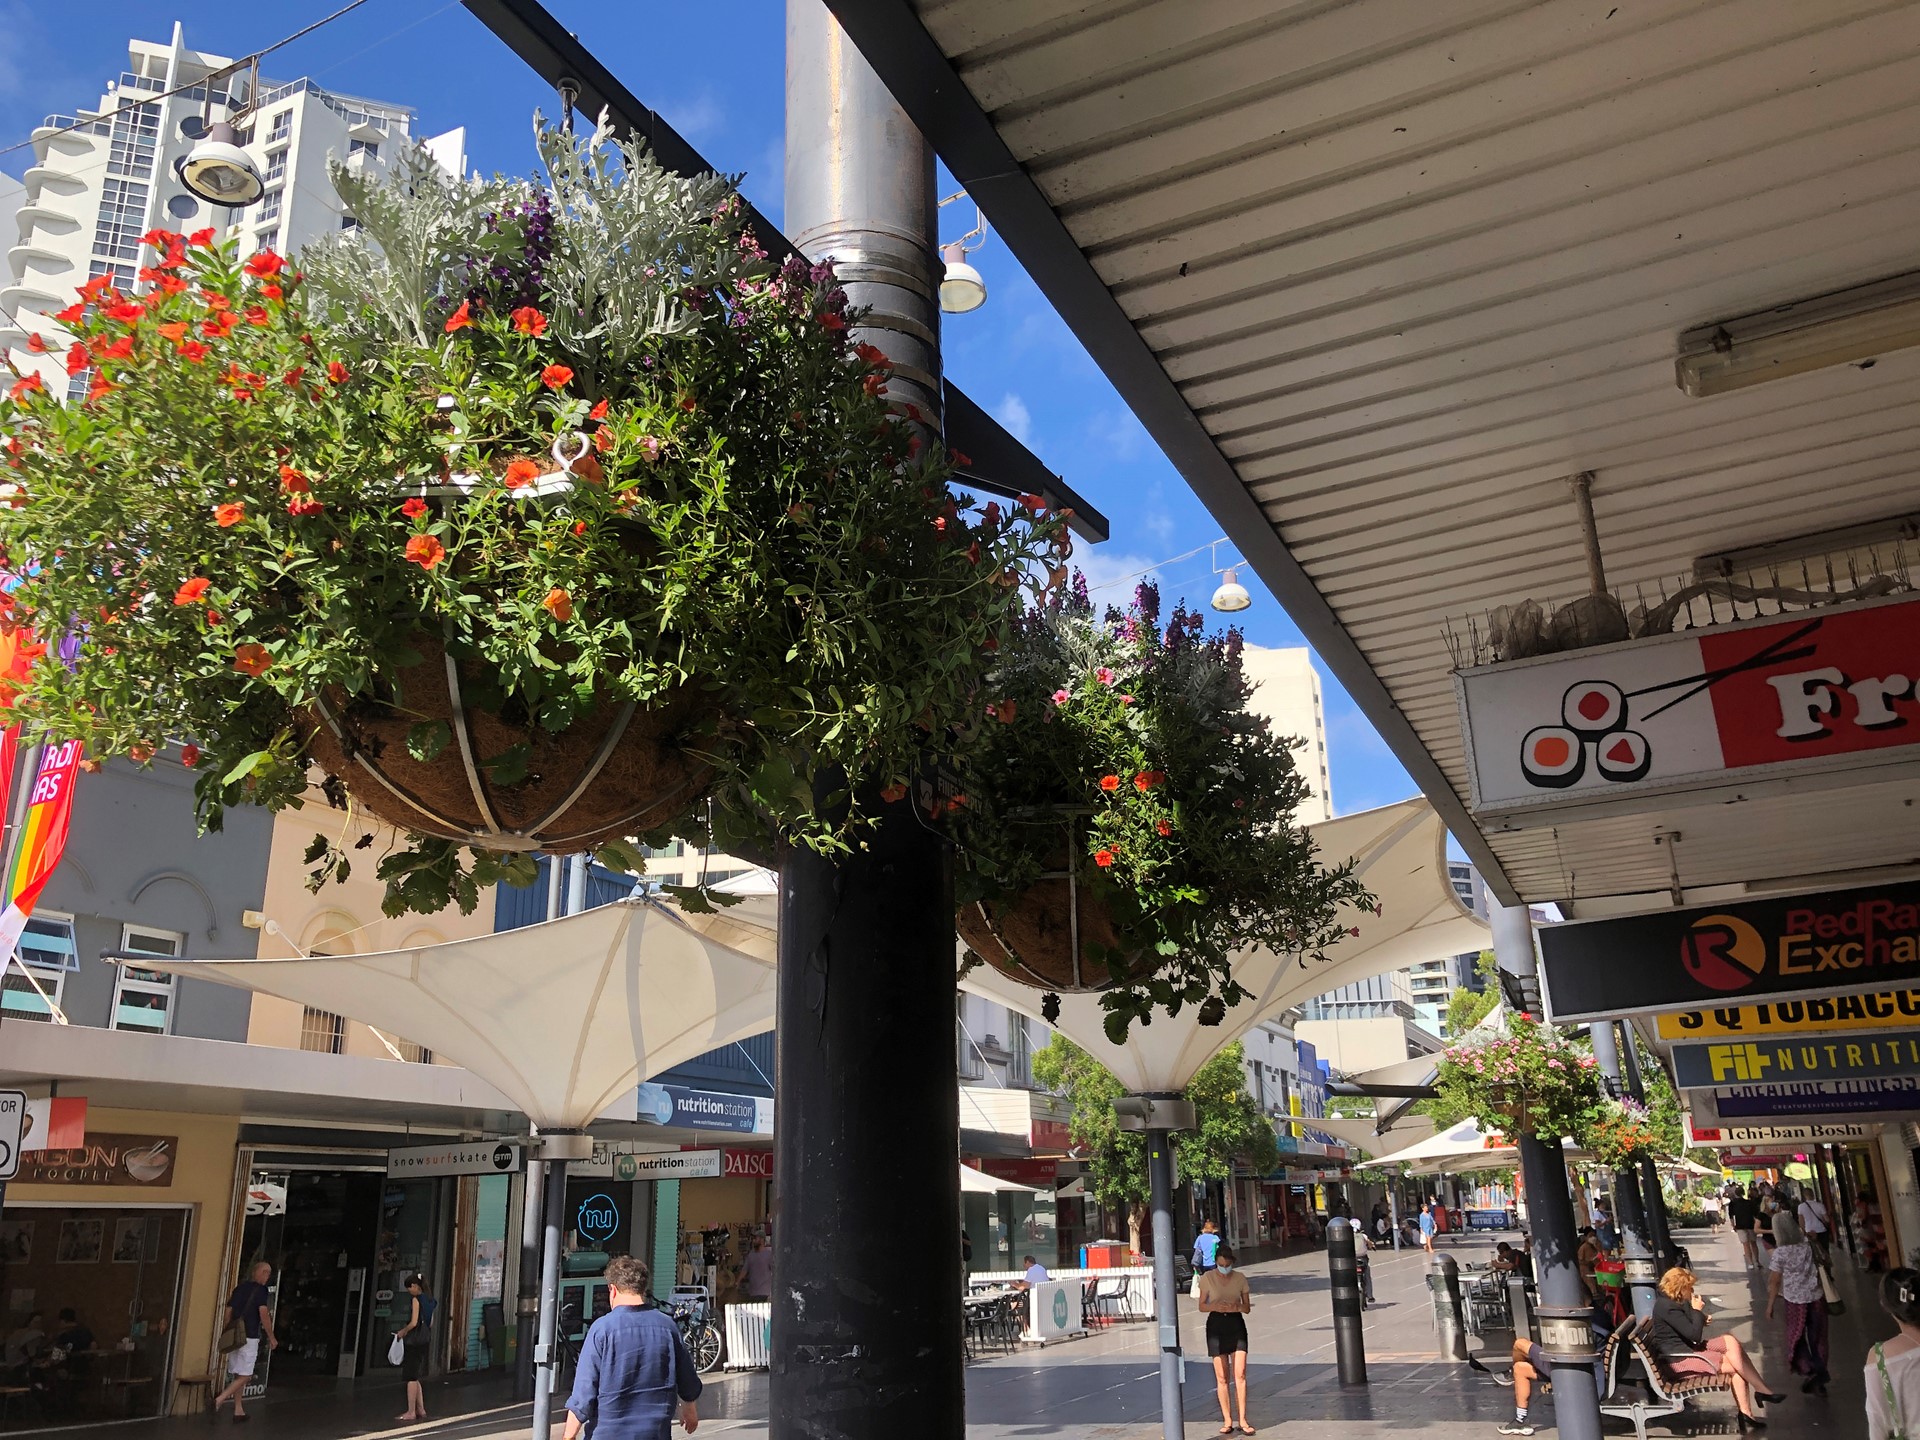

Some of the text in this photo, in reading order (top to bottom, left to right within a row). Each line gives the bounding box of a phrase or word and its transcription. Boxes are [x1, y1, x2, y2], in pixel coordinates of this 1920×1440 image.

[1766, 667, 1920, 738] Fr
[1787, 900, 1920, 939] RedRa
[1779, 932, 1920, 976] Excha
[0, 1100, 16, 1113] OR
[678, 1096, 724, 1115] nutrition
[724, 1101, 753, 1118] station
[1810, 1123, 1863, 1138] Boshi
[394, 1152, 488, 1167] snowsurfskate
[639, 1154, 684, 1170] nutrition
[684, 1156, 716, 1168] station
[1040, 1165, 1054, 1173] ATM
